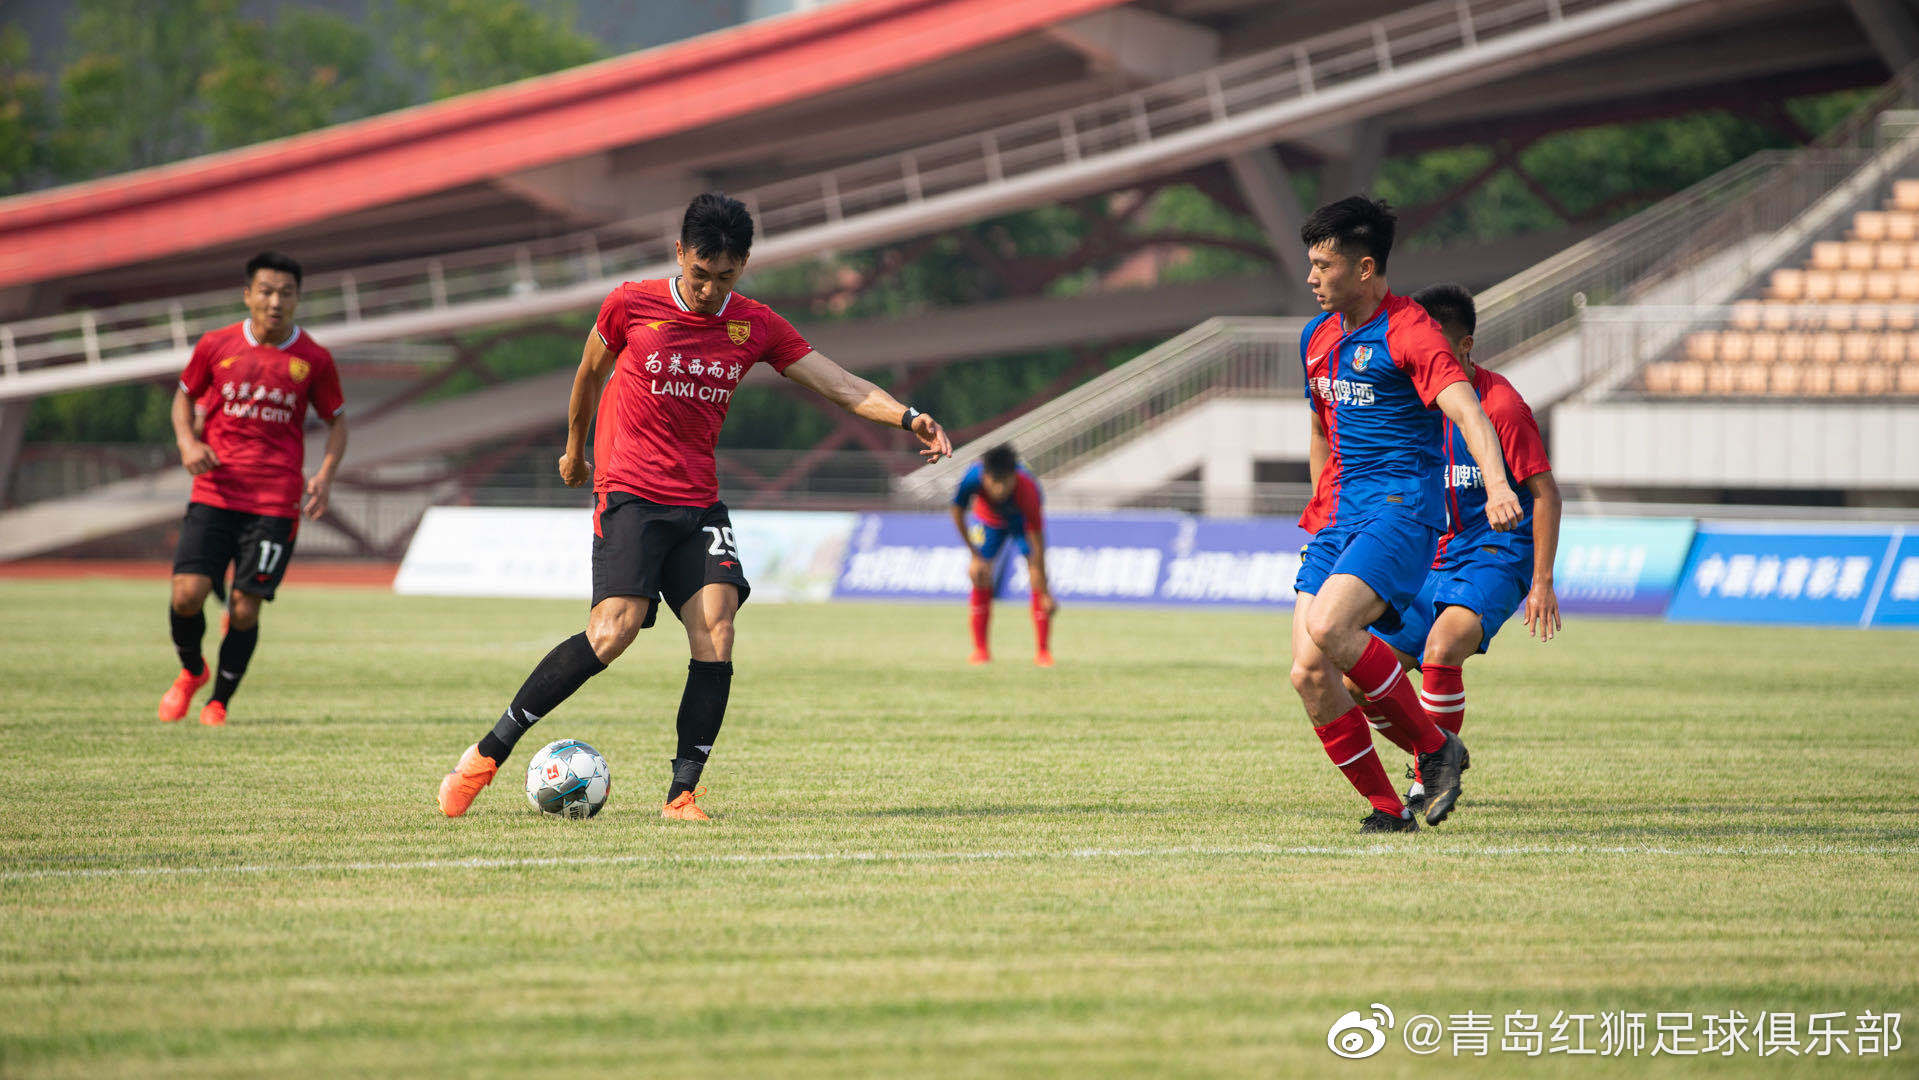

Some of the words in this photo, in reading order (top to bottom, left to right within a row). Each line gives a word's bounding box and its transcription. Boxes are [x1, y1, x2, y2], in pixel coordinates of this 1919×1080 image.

[645, 351, 743, 383] 为莱西而战
[651, 380, 695, 398] LAIXI
[699, 386, 734, 404] CITY
[258, 540, 283, 573] 17
[702, 526, 738, 560] 29
